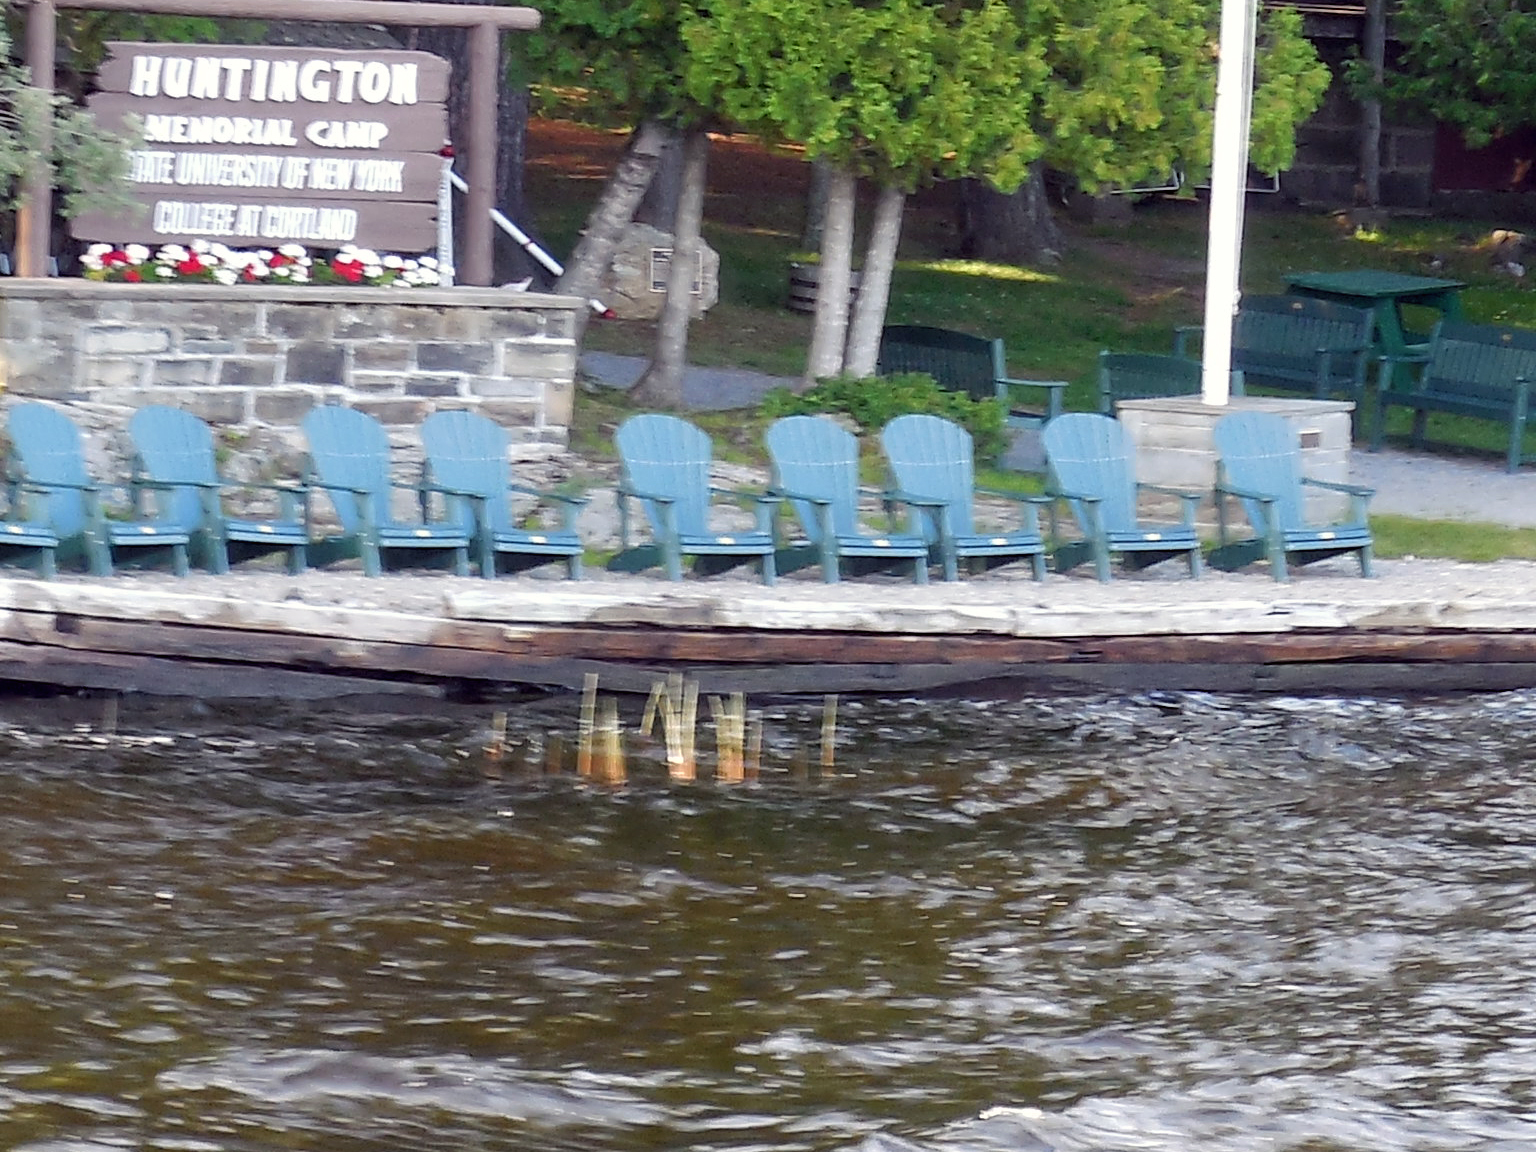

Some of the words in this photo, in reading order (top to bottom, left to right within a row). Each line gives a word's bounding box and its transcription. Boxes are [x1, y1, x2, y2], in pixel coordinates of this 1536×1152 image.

[130, 55, 418, 105] HUNTINGTON
[143, 114, 298, 147] MEMORIAL
[304, 121, 389, 149] CAMP
[175, 152, 284, 188] UNIVERSITY
[280, 156, 310, 190] OF
[307, 158, 353, 191] NEW
[352, 160, 406, 193] YORK
[152, 201, 238, 236] COLLEGE
[235, 204, 264, 237] AT
[260, 205, 359, 241] CORTLAND
